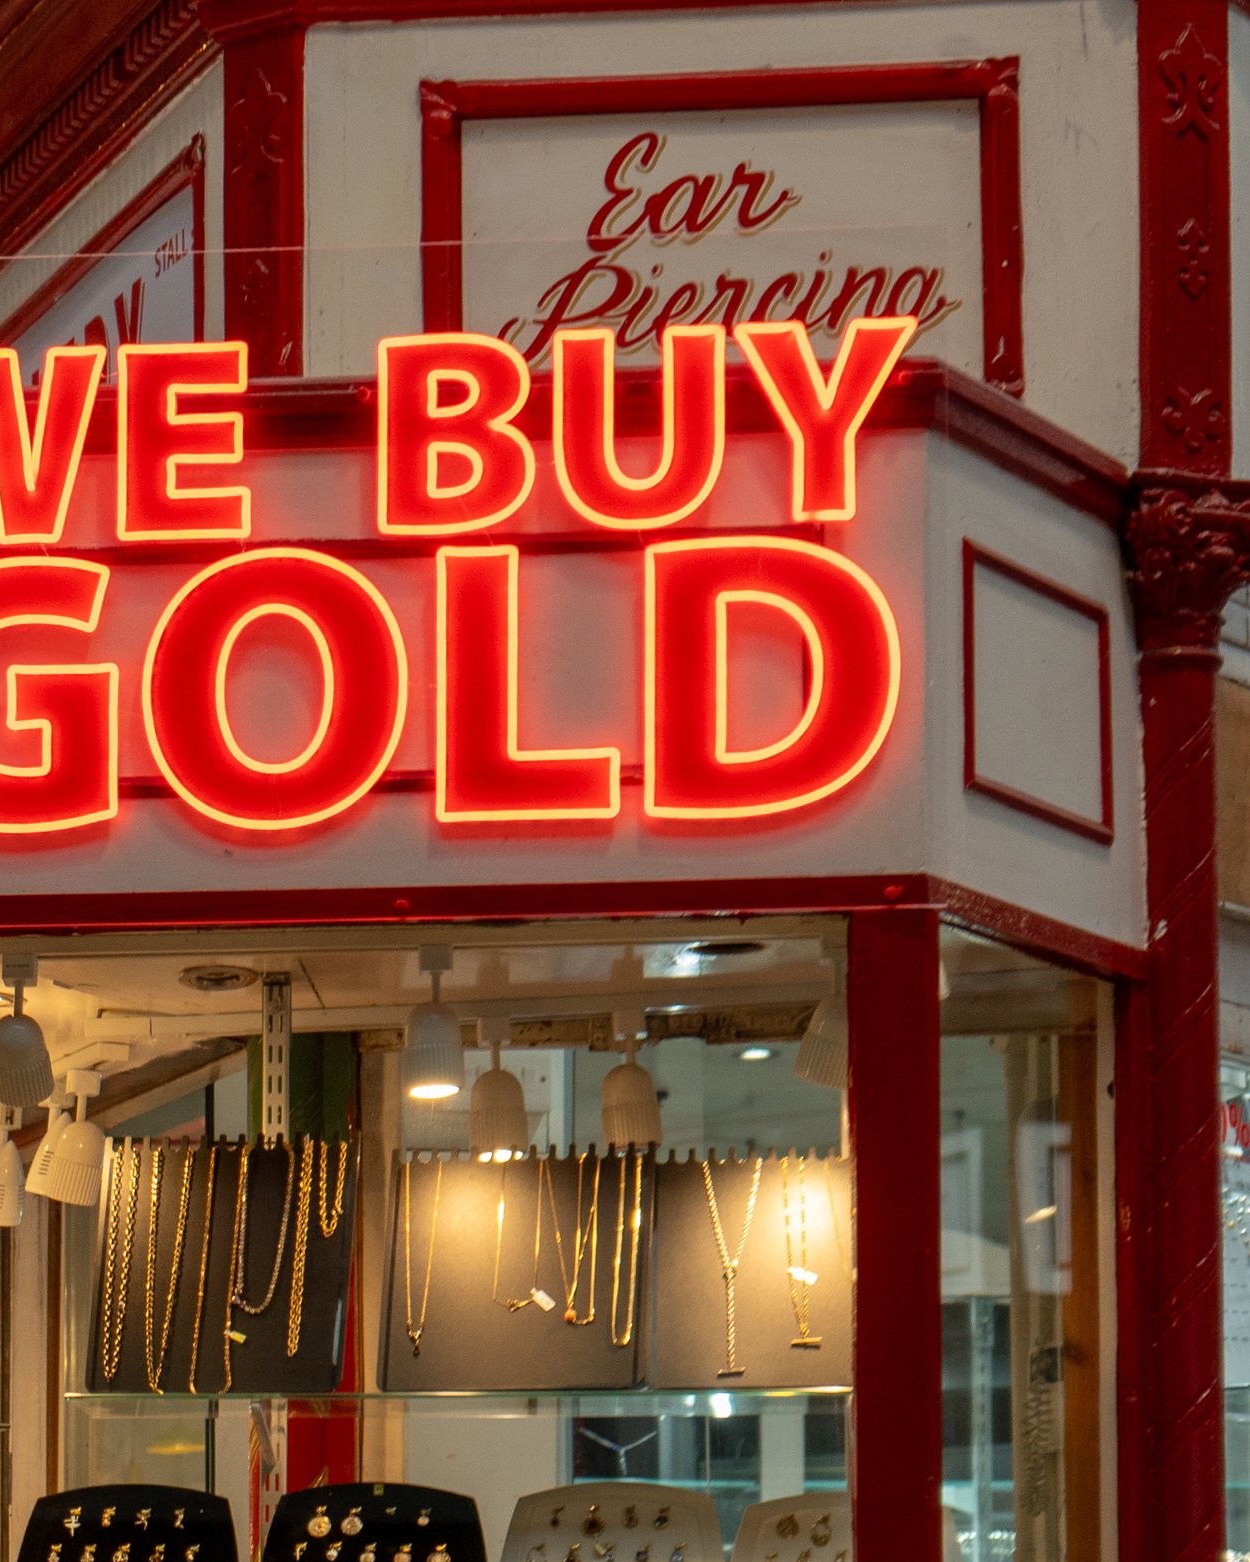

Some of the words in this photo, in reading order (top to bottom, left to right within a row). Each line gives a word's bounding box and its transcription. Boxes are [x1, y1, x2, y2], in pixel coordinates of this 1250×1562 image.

[586, 132, 803, 253] Ear
[154, 228, 187, 279] STALL
[497, 251, 962, 370] Piercing
[374, 315, 918, 536] BUY
